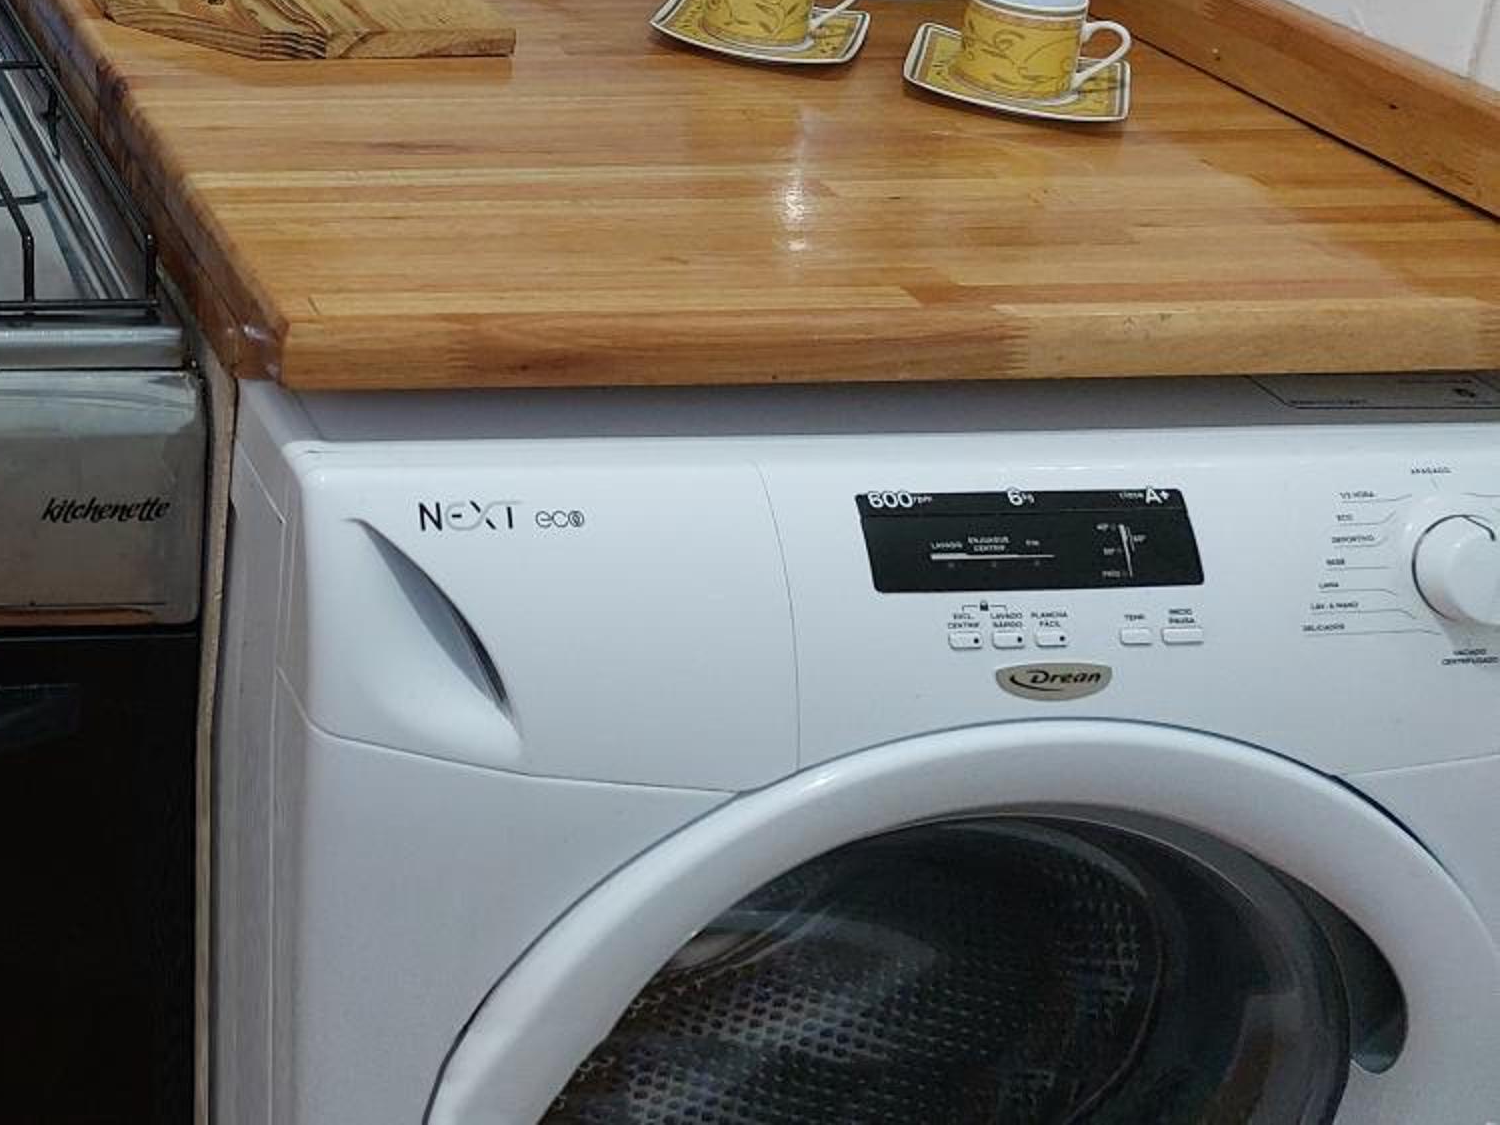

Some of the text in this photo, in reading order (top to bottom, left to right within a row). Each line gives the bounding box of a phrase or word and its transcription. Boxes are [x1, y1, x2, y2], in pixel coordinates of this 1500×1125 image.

[42, 497, 170, 523] kitchenette
[419, 499, 585, 531] NEXT eco
[1026, 669, 1102, 684] Drean
